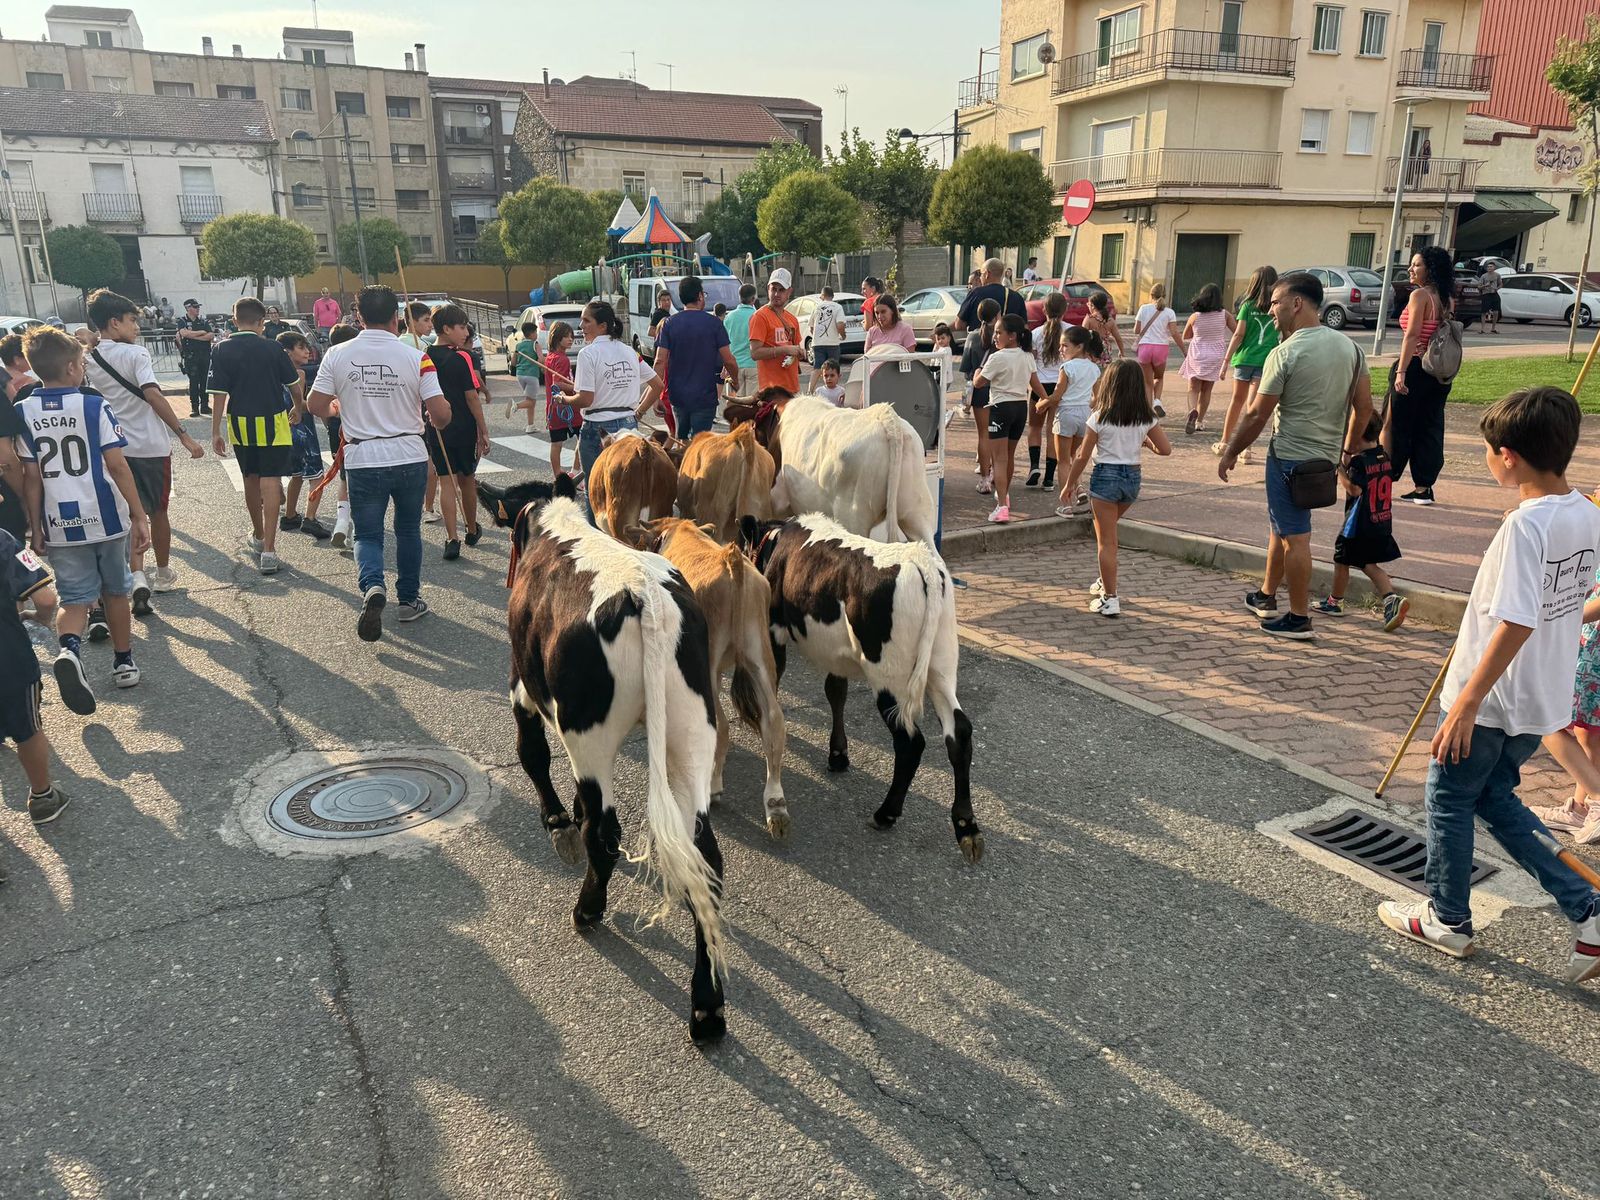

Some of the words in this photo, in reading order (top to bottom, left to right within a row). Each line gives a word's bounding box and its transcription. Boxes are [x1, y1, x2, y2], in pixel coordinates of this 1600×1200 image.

[351, 361, 377, 382] Tauro
[33, 416, 77, 431] ÓSCAR
[34, 435, 89, 478] 20
[1368, 475, 1392, 513] 19
